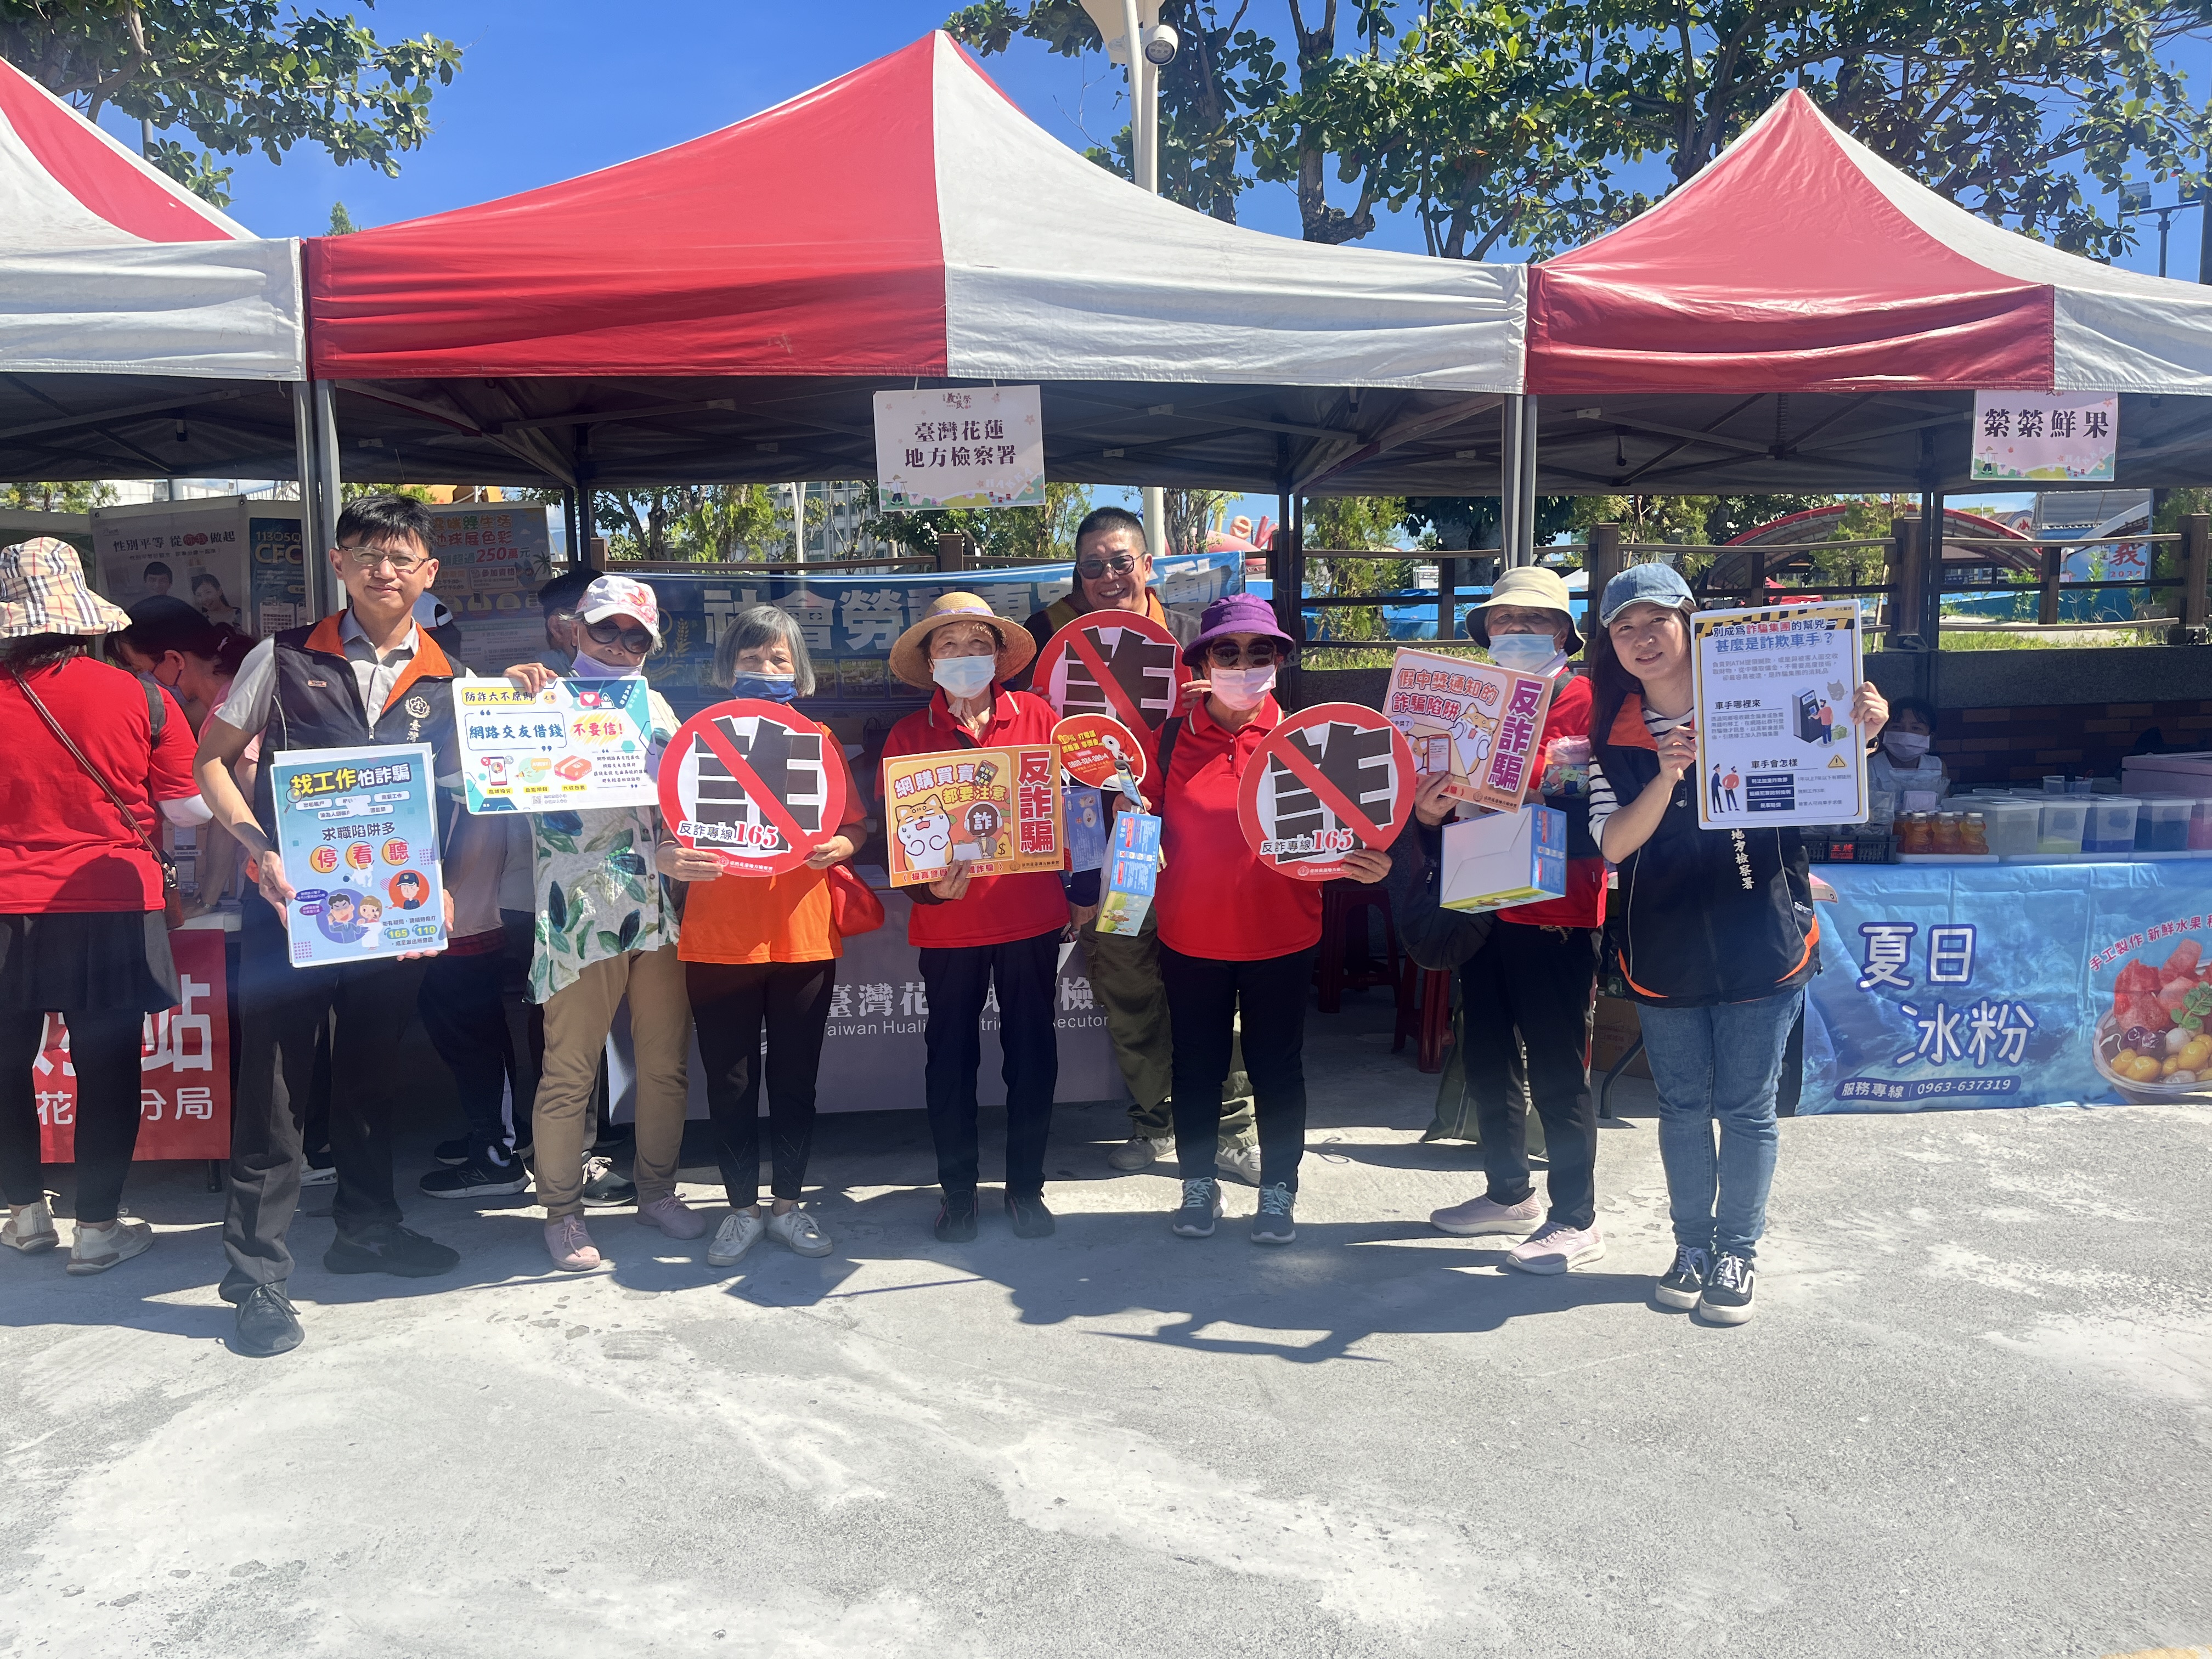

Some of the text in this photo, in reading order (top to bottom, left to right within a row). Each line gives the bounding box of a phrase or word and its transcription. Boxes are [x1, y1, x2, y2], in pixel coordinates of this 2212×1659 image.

[915, 420, 1004, 442] 臺灣花蓮
[905, 445, 1016, 467] 地方檢察署
[113, 535, 165, 552] 性別平等
[1716, 632, 1834, 653] 甚麼是詐欺車手？
[465, 691, 534, 703] 防詐六不原則
[1398, 669, 1499, 706] 假中獎通知的
[1392, 692, 1461, 721] 詐騙陷阱
[1715, 699, 1761, 709] 車手哪裡來
[470, 723, 564, 740] 網路交友借錢
[1487, 679, 1544, 792] 反詐騙
[1751, 759, 1798, 769] 車手會怎樣
[291, 763, 410, 795] 找工作怕詐騙
[894, 764, 976, 799] 網購買賣
[942, 786, 1007, 804] 都要注意
[1017, 750, 1054, 854] 反詐騙
[322, 821, 396, 840] 求職陷阱多
[973, 812, 992, 831] 詐
[317, 842, 409, 868] 停 看 聽
[1731, 828, 1754, 889] 地方檢察署
[389, 926, 436, 938] 165 110
[2147, 916, 2201, 941] 新鮮水果
[1860, 926, 1974, 989] 夏日
[2089, 934, 2143, 970] 手工製作
[883, 1019, 926, 1034] Huali
[1897, 1001, 2034, 1066] 冰粉
[1841, 1079, 2011, 1098] 服務專線 0963-637319
